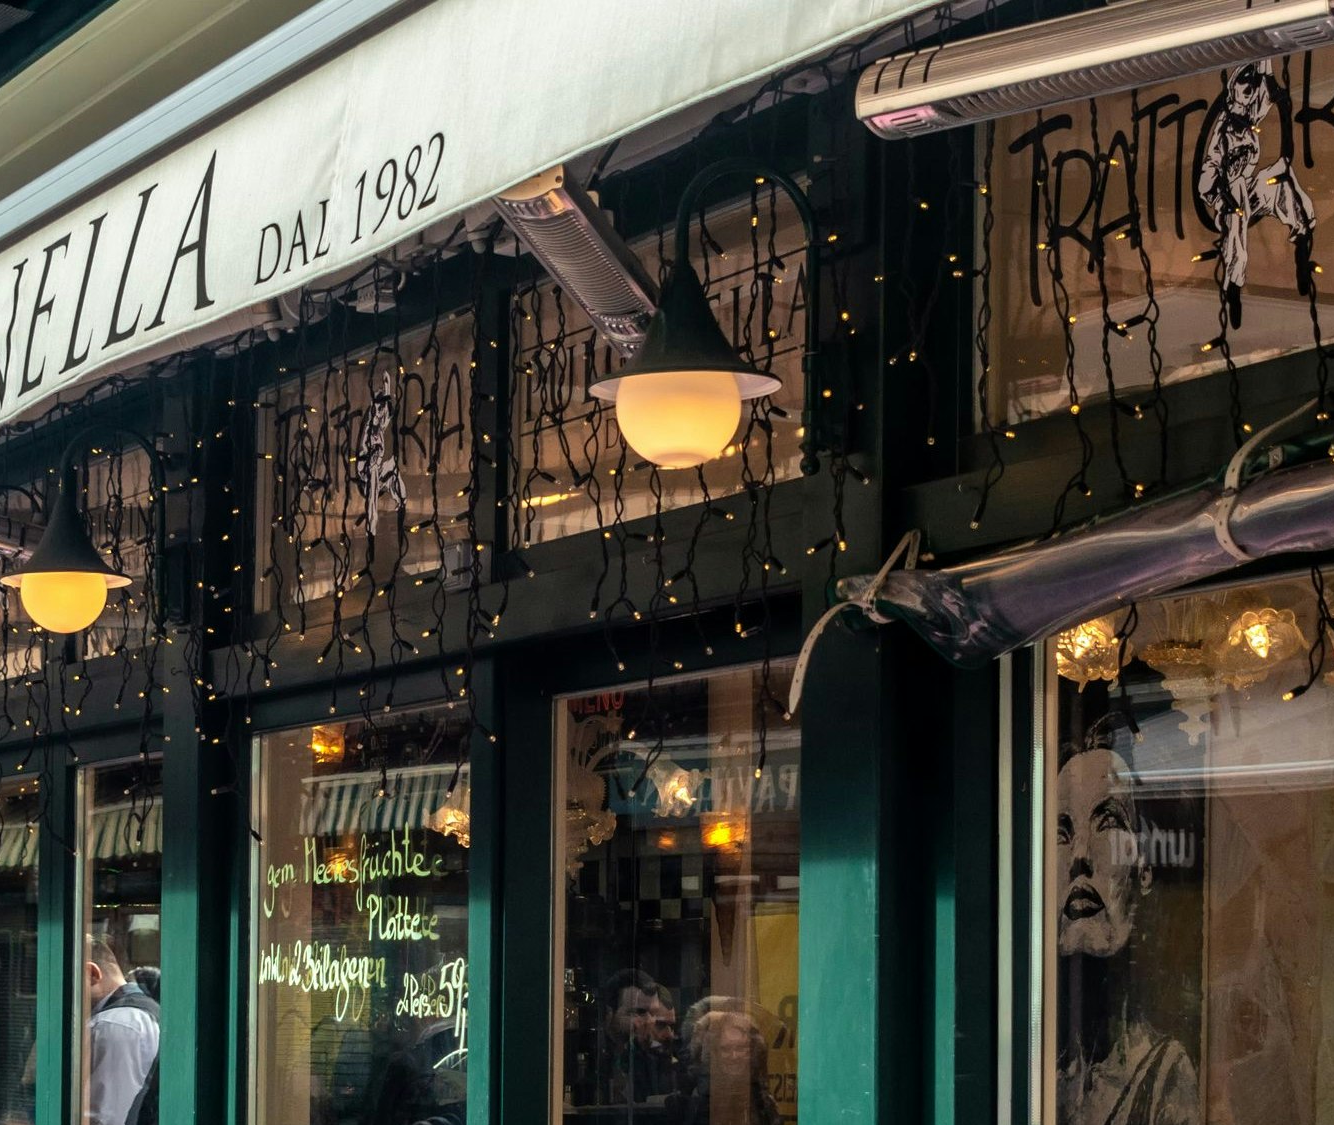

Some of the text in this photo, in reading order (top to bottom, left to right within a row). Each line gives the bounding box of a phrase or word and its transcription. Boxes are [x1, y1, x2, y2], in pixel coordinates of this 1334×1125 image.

[254, 198, 330, 286] DAL
[349, 131, 446, 243] 1982
[366, 893, 423, 941] Platte
